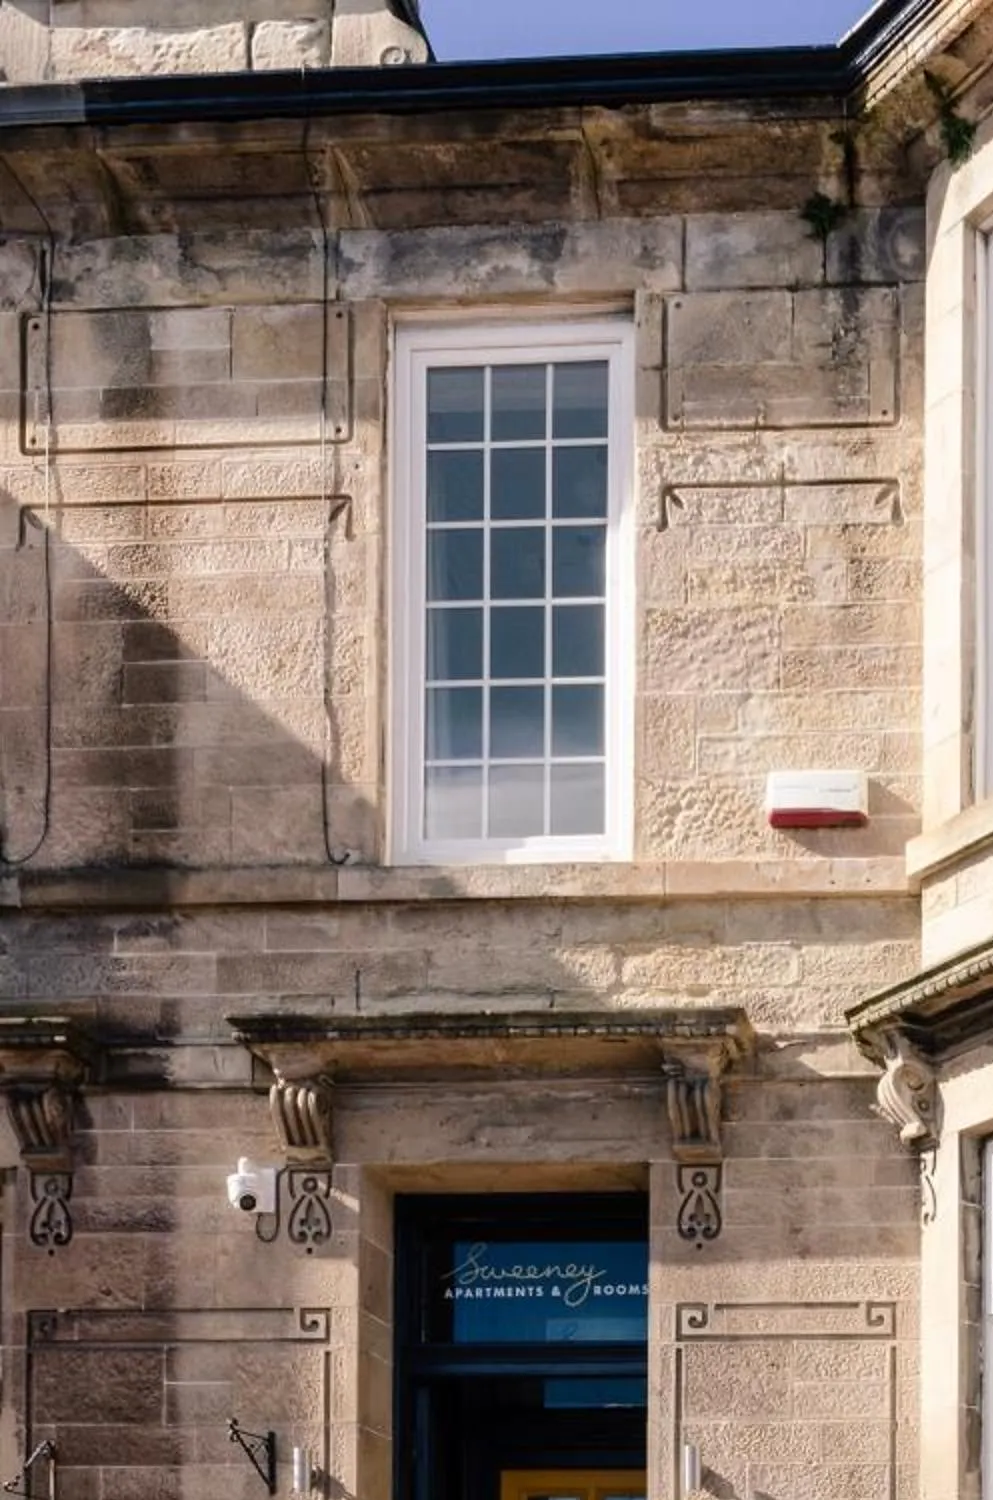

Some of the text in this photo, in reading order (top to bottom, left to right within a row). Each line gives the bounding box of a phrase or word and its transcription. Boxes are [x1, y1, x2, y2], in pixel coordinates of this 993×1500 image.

[440, 1243, 607, 1307] Sweeney
[444, 1285, 545, 1299] APARTMENTS
[551, 1285, 562, 1298] &
